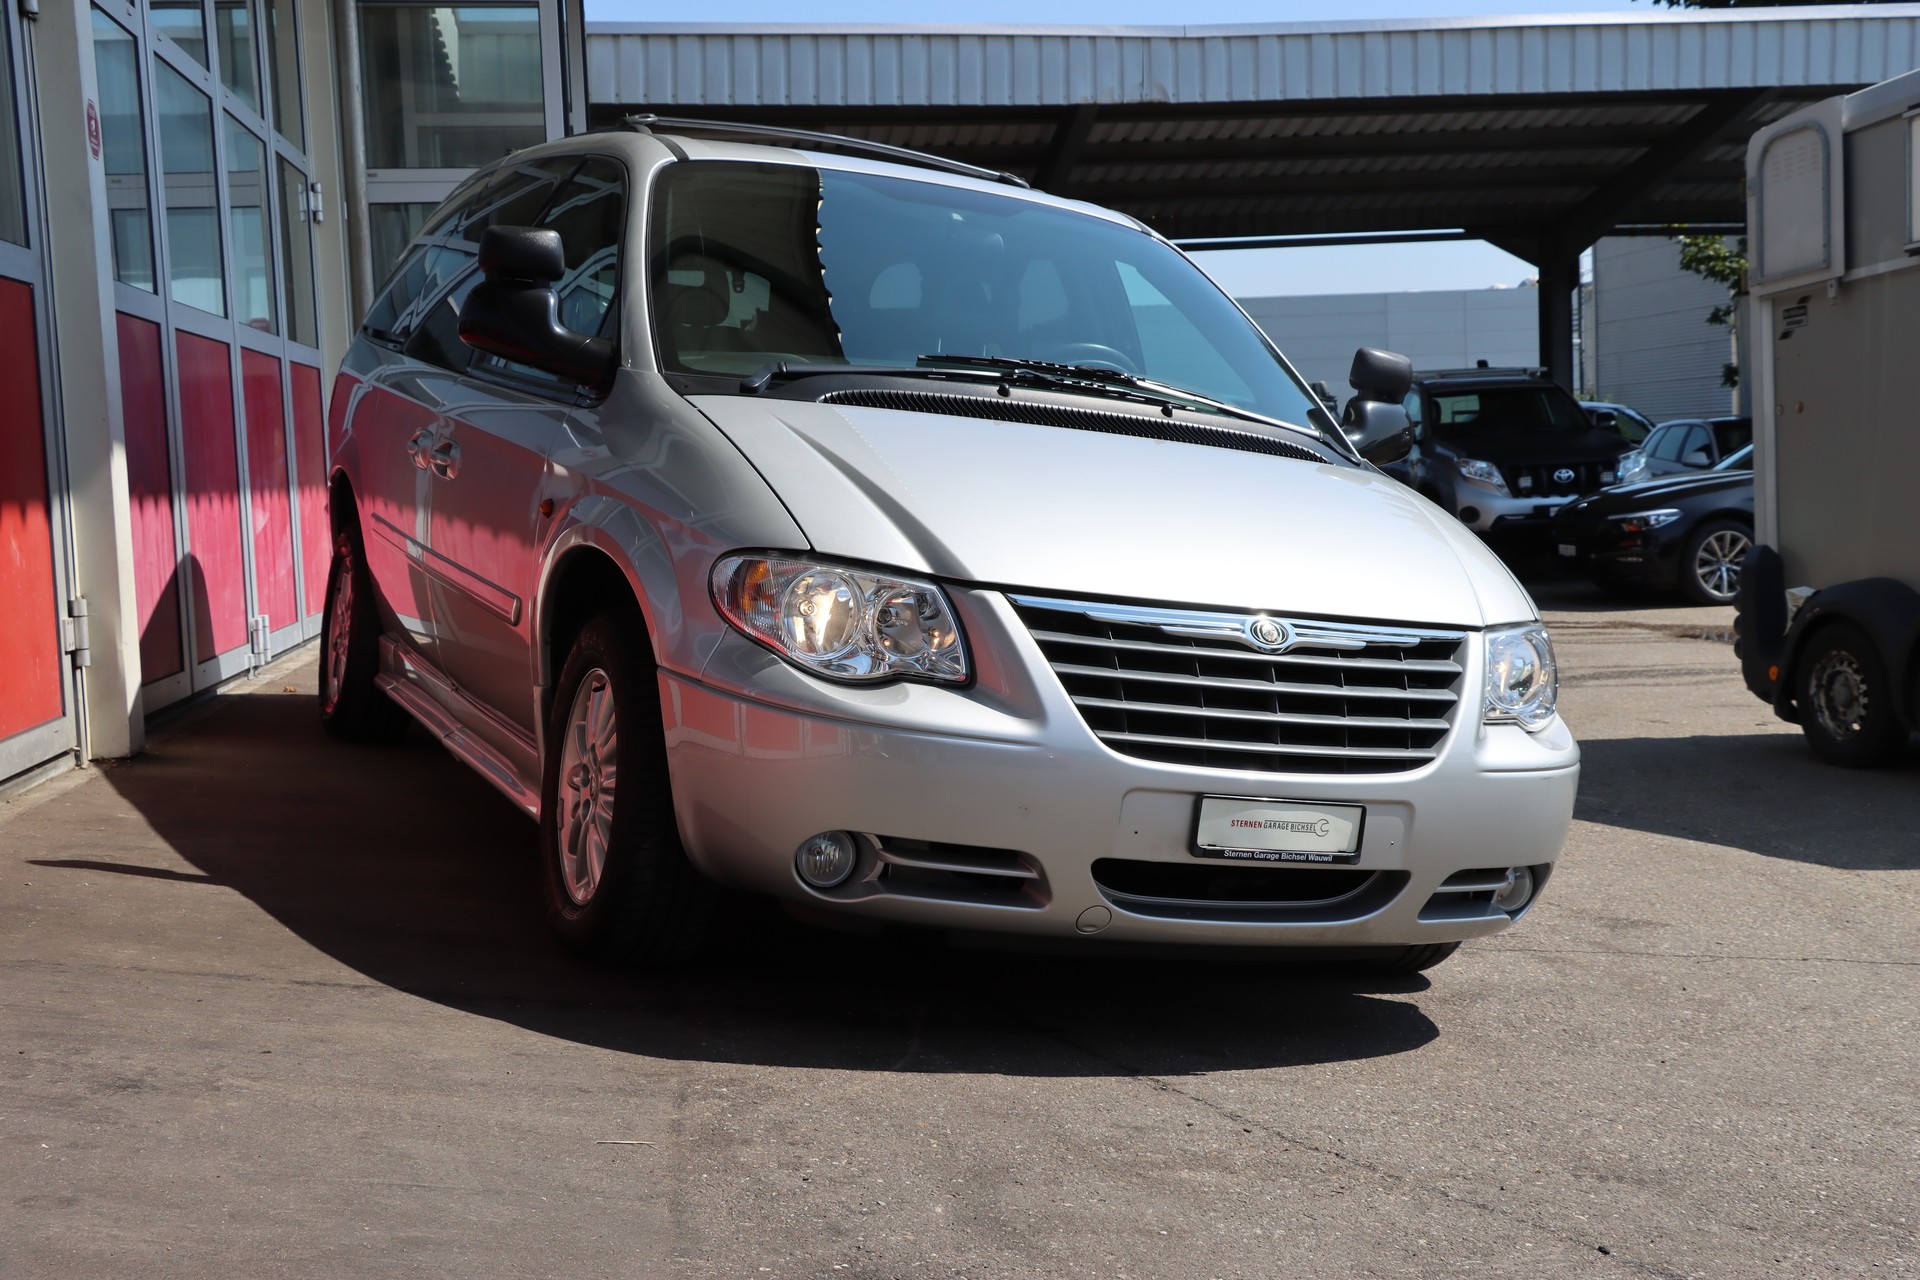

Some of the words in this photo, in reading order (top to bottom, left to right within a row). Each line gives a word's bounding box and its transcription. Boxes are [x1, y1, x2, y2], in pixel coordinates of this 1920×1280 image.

[1231, 819, 1262, 829] STERNEN
[1263, 821, 1289, 830] GARAGE
[1290, 823, 1316, 832] BICHSEL
[1224, 849, 1252, 858] Sternen
[1253, 851, 1279, 860] Garage
[1281, 852, 1306, 861] Bichsel
[1308, 854, 1333, 862] Wauwil
